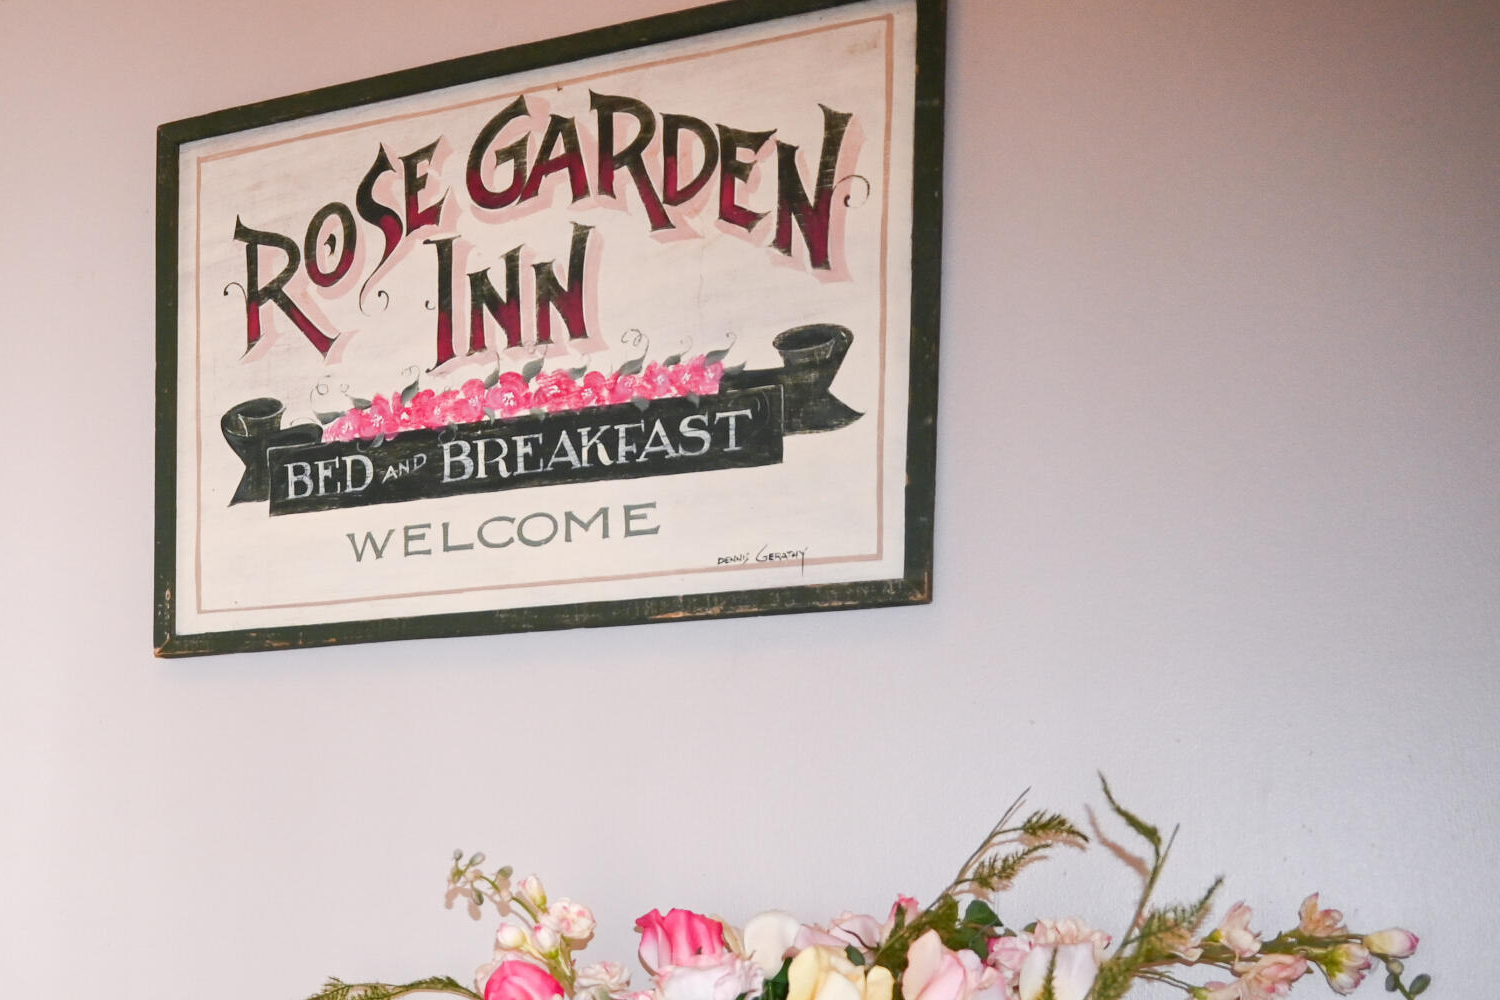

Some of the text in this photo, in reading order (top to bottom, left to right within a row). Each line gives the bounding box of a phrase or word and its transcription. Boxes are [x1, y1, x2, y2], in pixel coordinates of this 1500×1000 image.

[231, 88, 860, 361] ROSE GARDEN
[423, 221, 596, 373] INN
[286, 408, 753, 500] BED AND BREAKFAST
[346, 502, 661, 563] WELCOME
